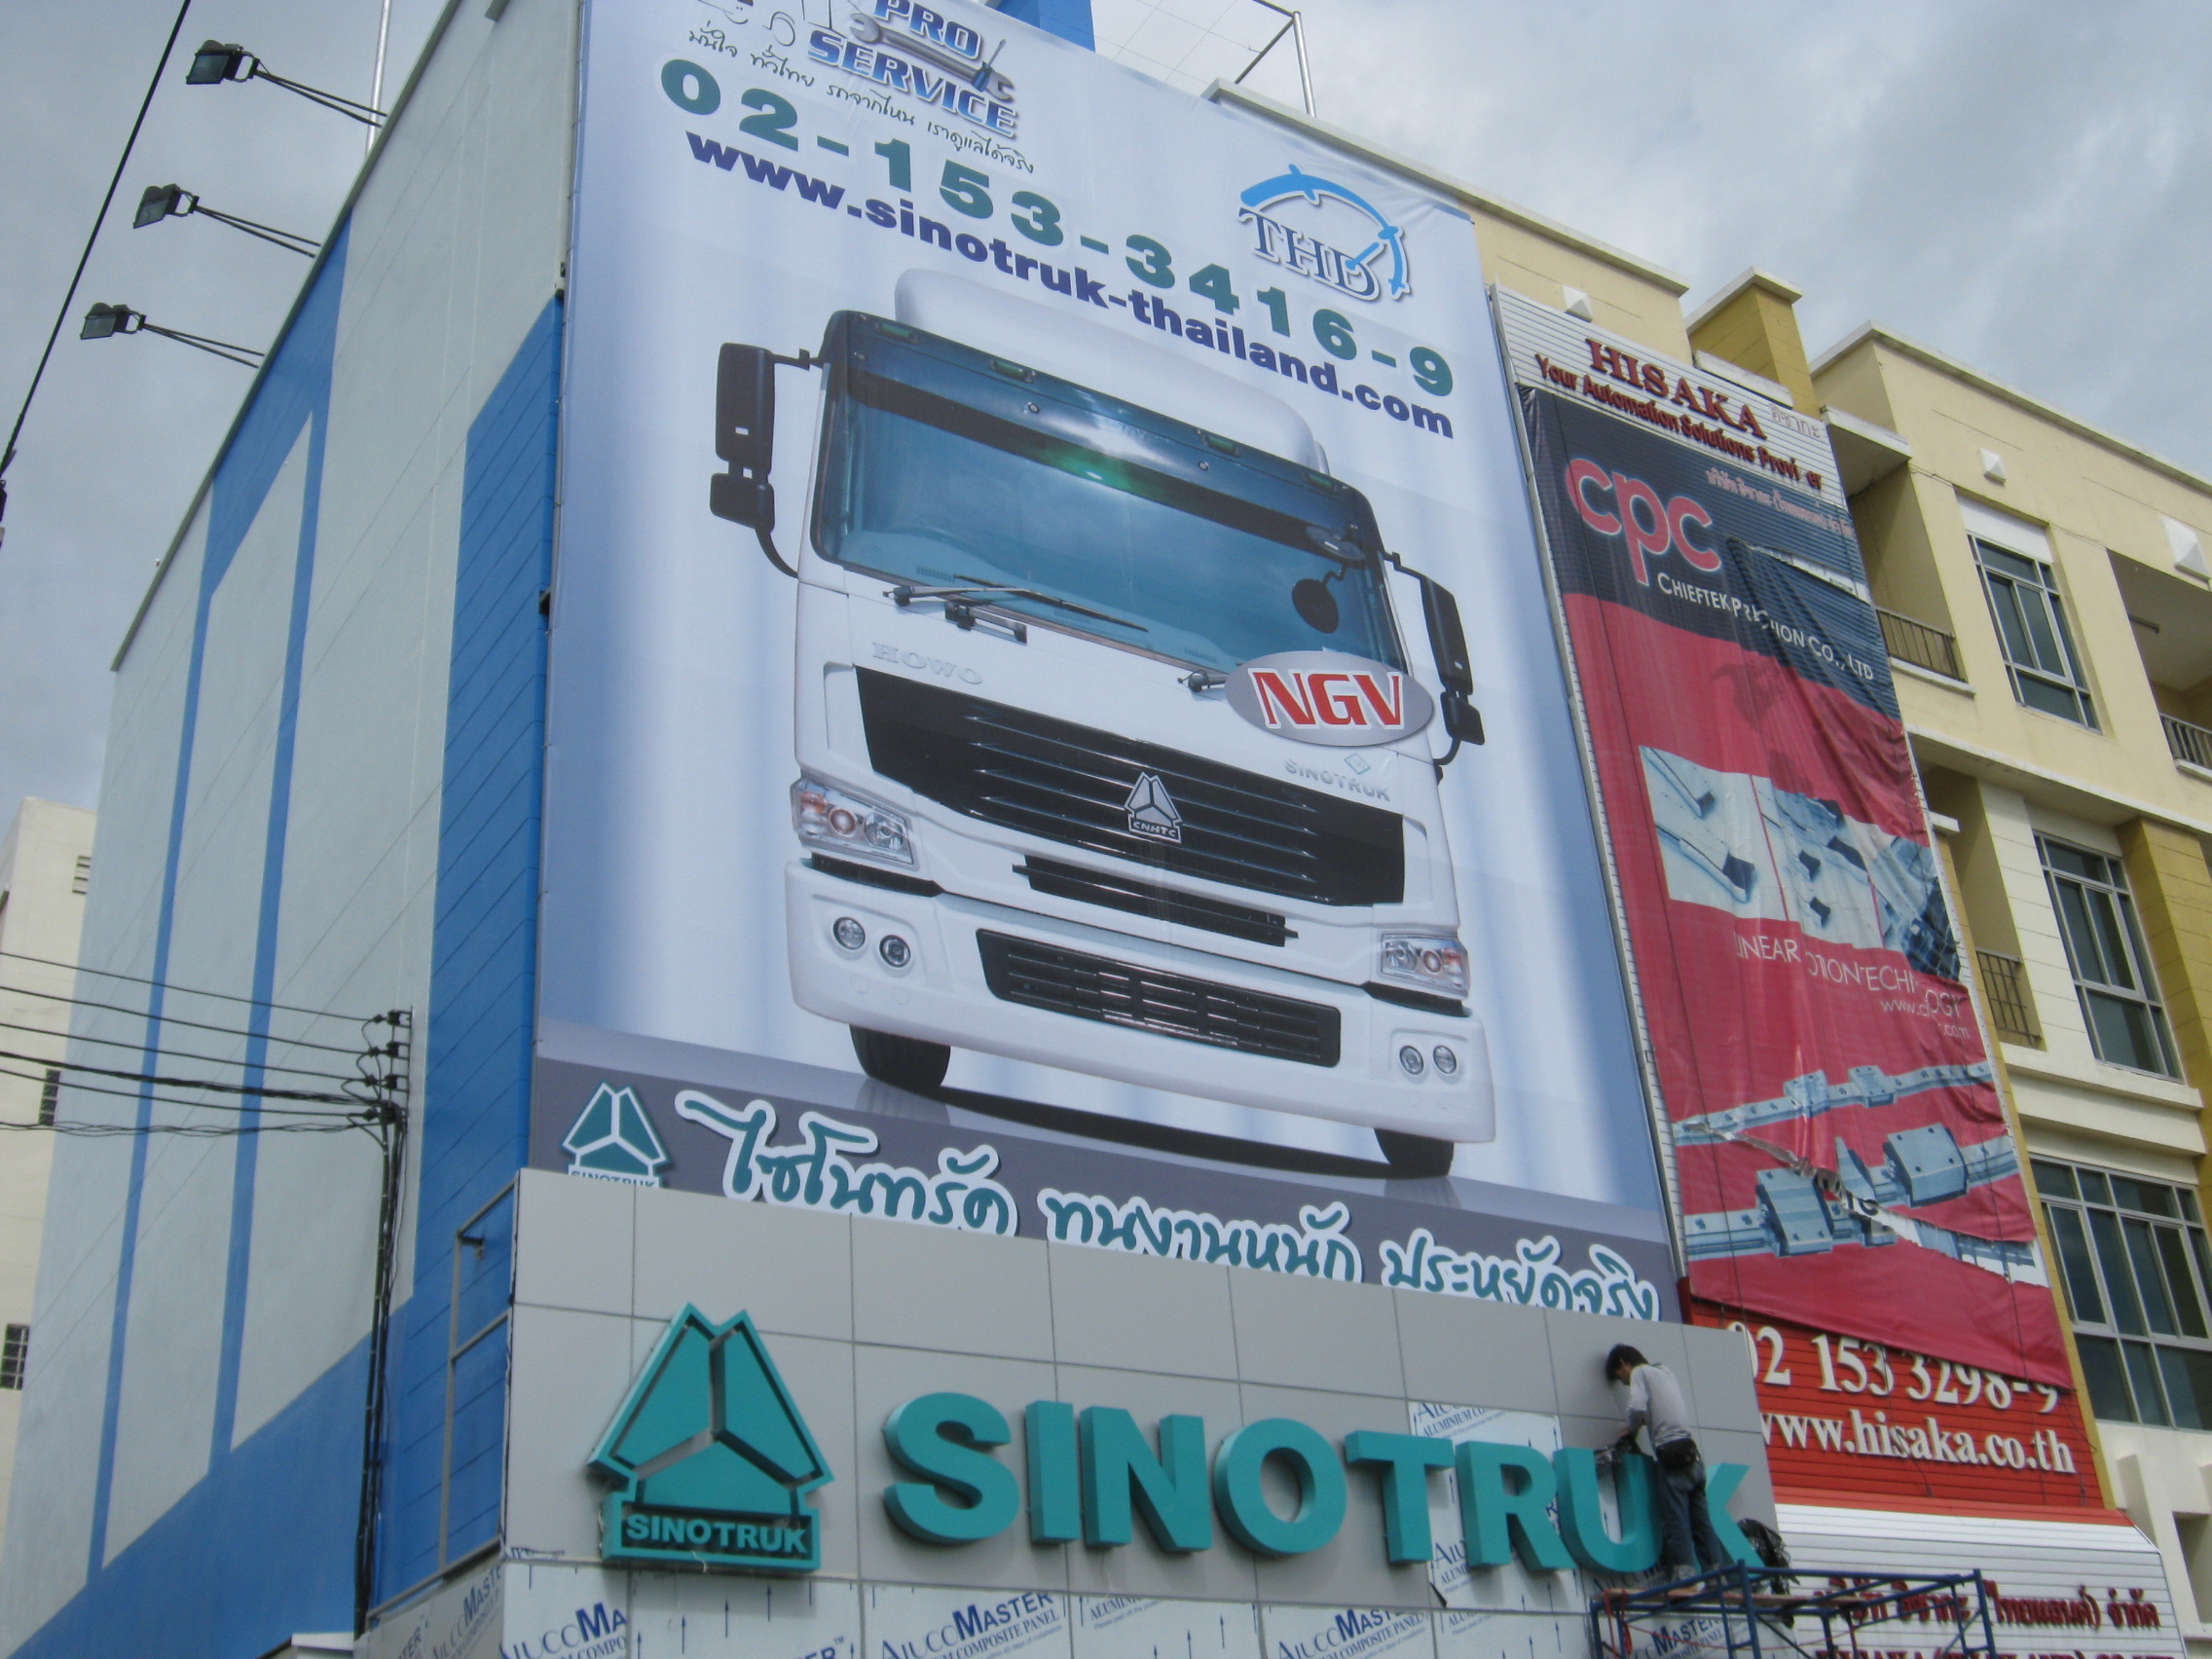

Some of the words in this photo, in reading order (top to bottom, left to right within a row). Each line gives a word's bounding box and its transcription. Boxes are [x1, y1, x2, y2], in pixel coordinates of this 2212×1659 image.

[873, 0, 980, 60] PRO
[807, 29, 1018, 138] SERVICE
[685, 130, 1454, 438] www.sinotruk-thailand.com
[1534, 353, 1577, 391] Your
[1582, 374, 1680, 432] Automation
[1679, 413, 1756, 463] Solutions
[1585, 338, 1768, 440] HISAKA
[1657, 571, 1731, 612] CHIEFTEK
[1249, 669, 1404, 728] NGV
[1284, 758, 1391, 802] SINOTRUK
[1132, 821, 1177, 837] CNHTC
[628, 1514, 808, 1555] SINOTRUK
[1021, 1608, 1060, 1635] PANEL
